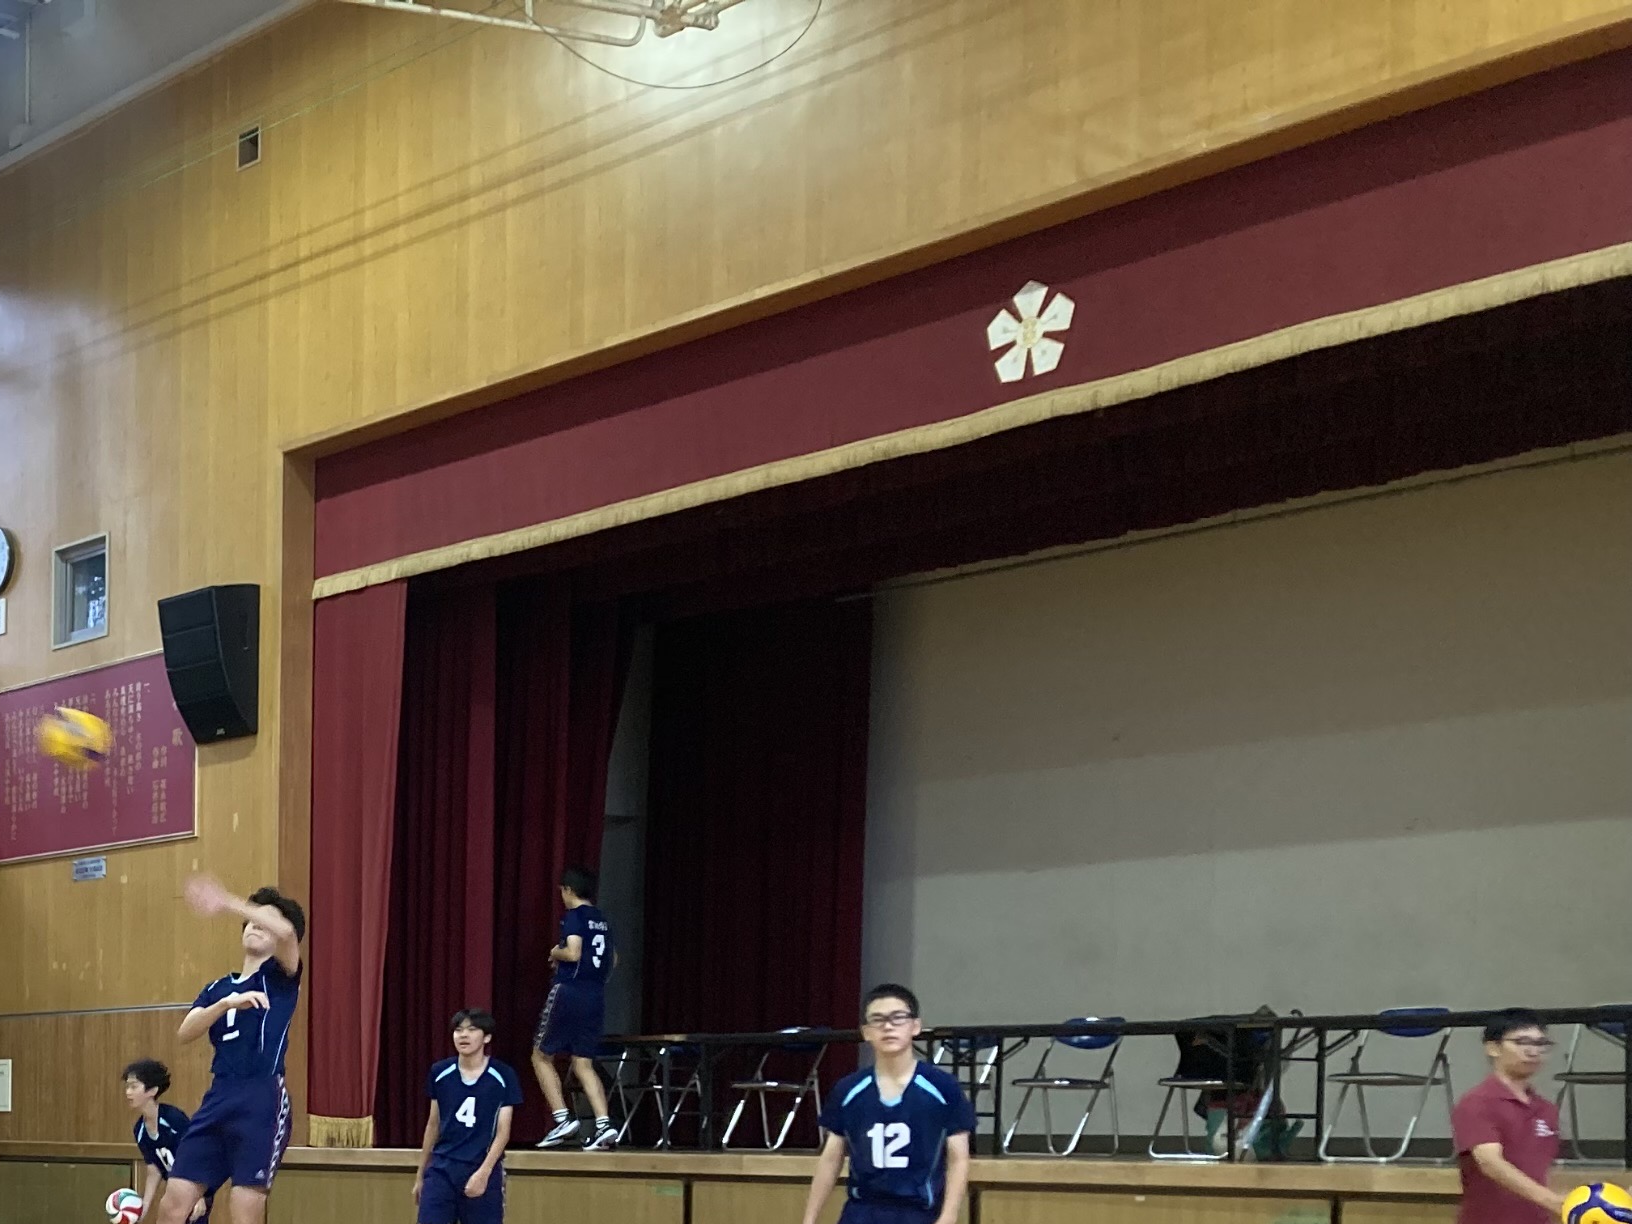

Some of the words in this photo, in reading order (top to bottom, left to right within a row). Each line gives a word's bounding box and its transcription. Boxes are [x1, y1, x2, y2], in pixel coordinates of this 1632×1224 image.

[591, 934, 606, 969] 3
[455, 1096, 476, 1128] 4
[866, 1122, 911, 1169] 12
